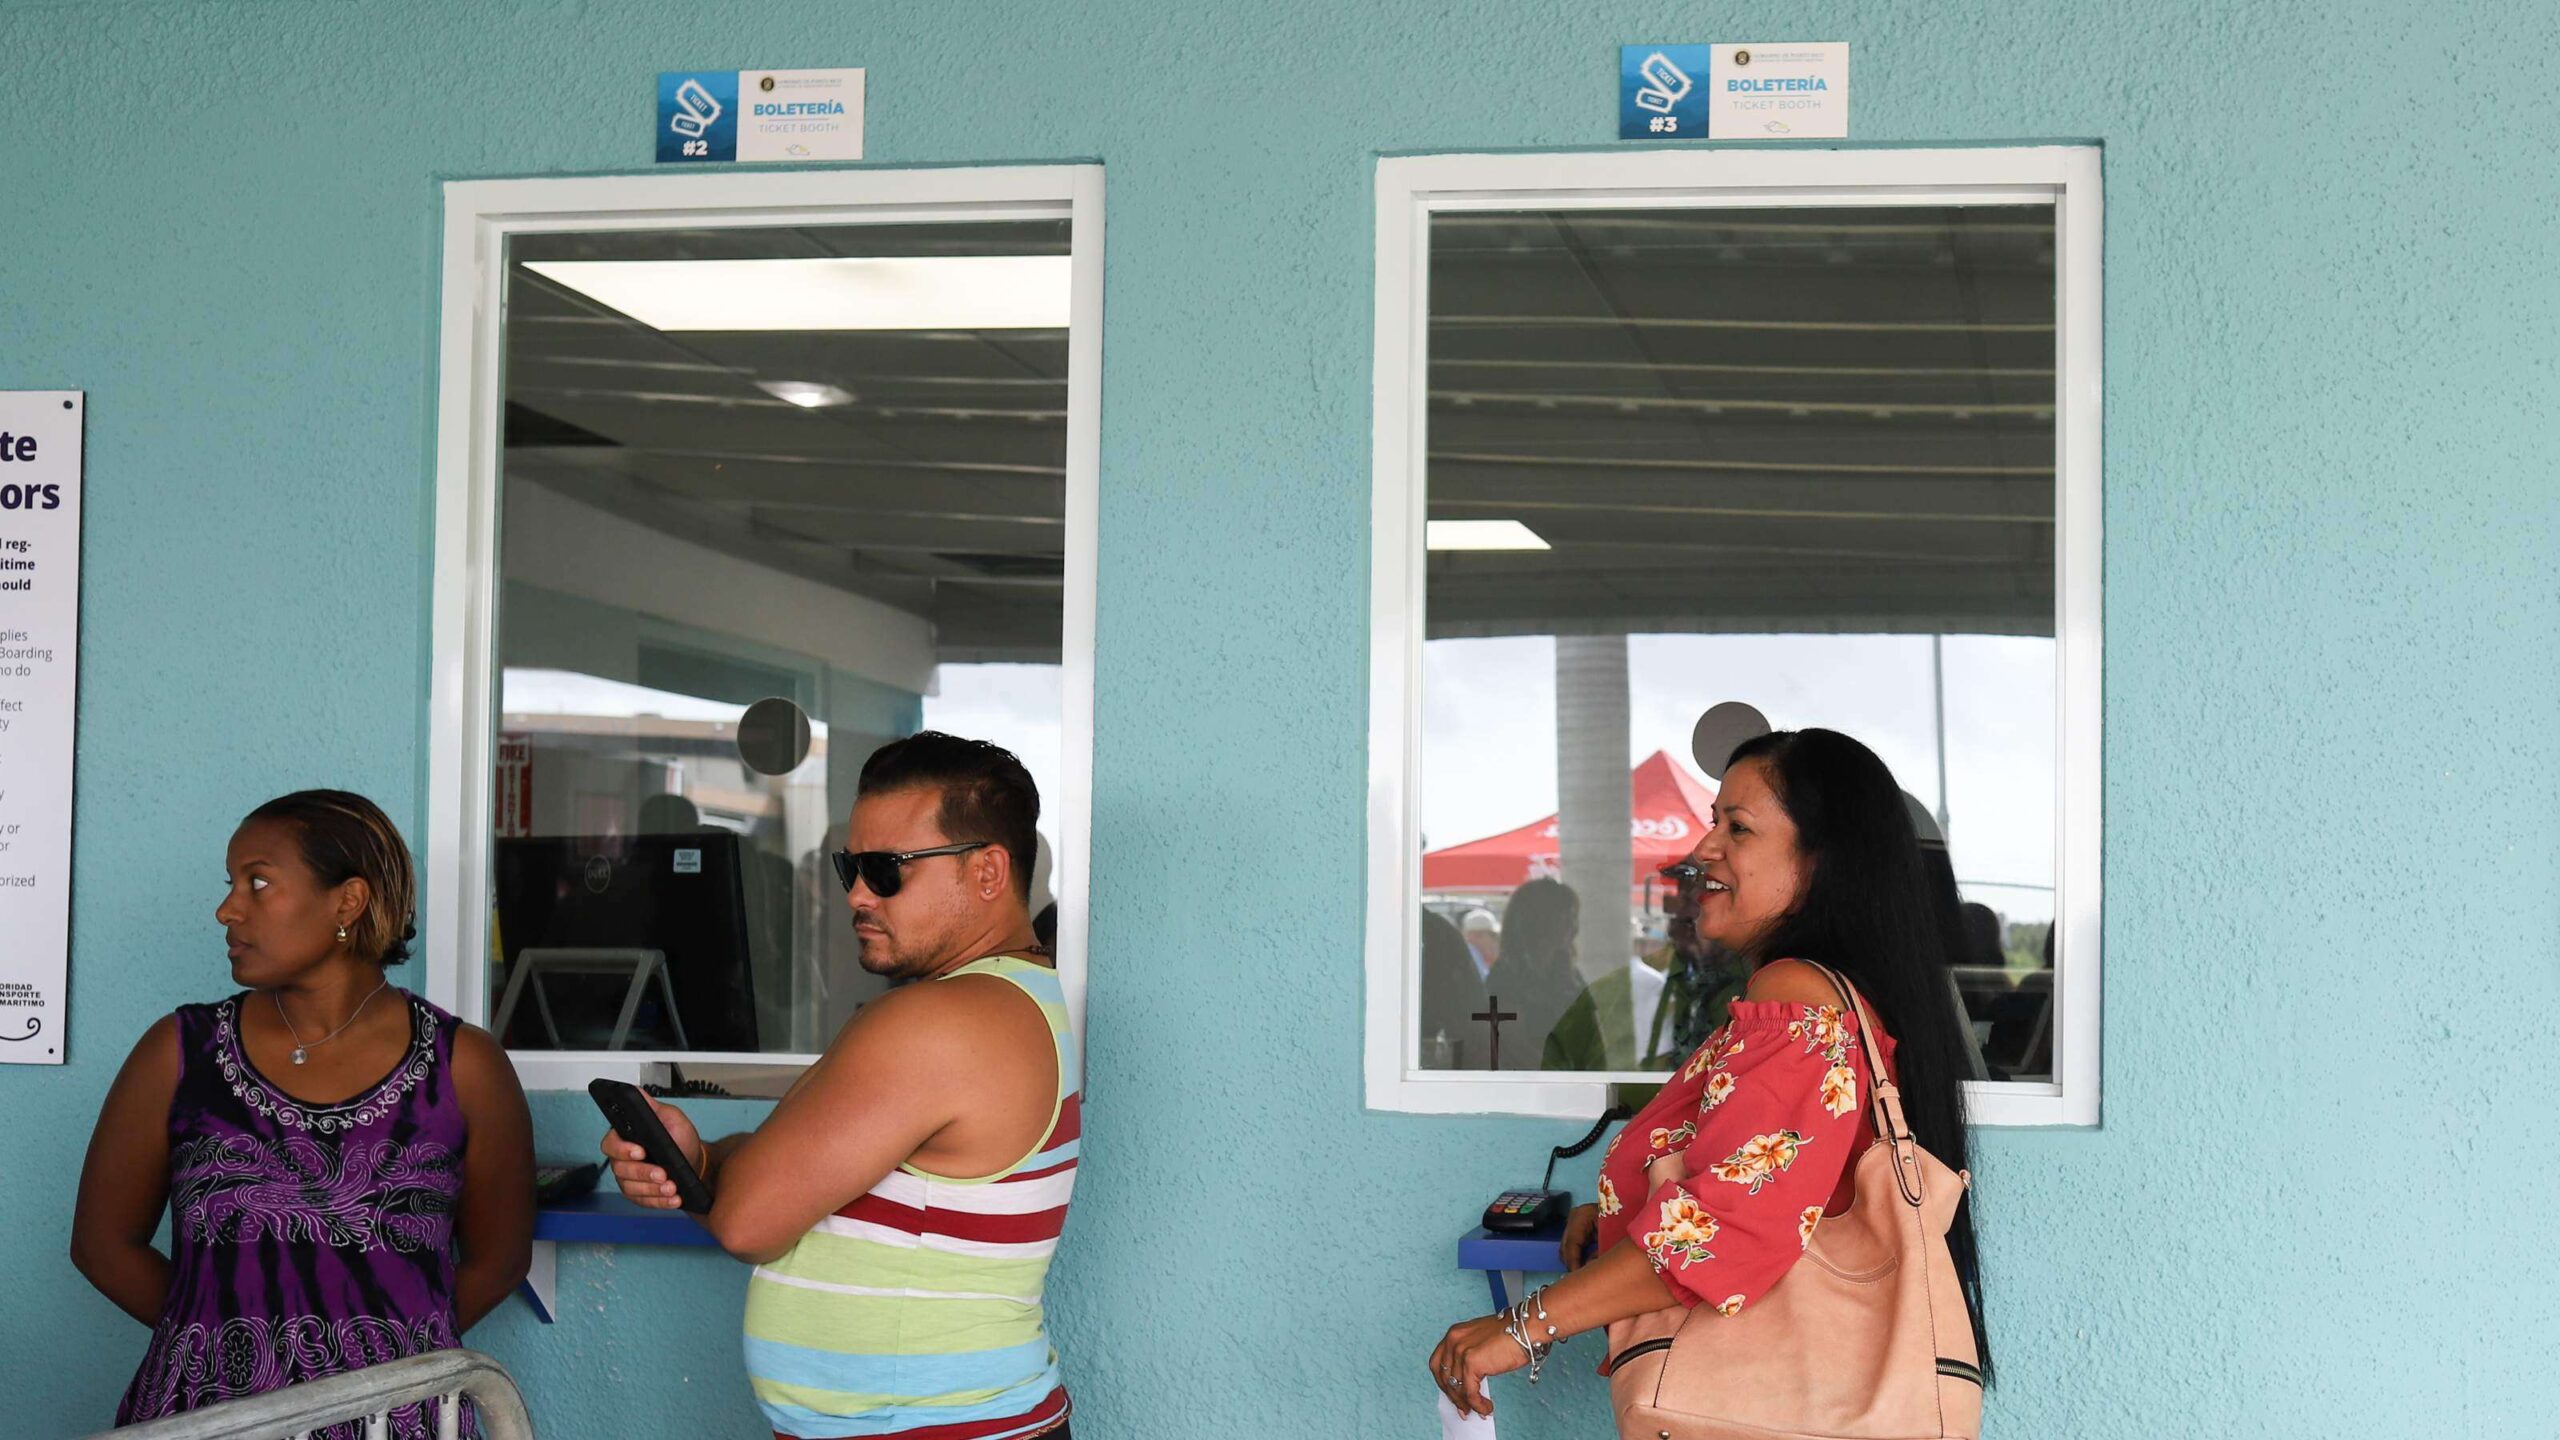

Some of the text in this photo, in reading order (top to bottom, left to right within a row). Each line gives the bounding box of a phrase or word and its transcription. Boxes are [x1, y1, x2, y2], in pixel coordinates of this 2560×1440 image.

[1727, 75, 1827, 92] BOLETERÍA
[754, 99, 844, 116] BOLETERÍA
[1732, 100, 1822, 110] TICKET BOOTH
[760, 122, 839, 133] TICKET BOOTH
[1649, 116, 1678, 132] #3
[683, 140, 708, 156] #2
[0, 432, 37, 462] te
[0, 484, 60, 509] ors
[6, 540, 31, 553] reg-
[0, 579, 31, 590] ould
[0, 646, 53, 662] Boarding
[15, 664, 31, 676] do
[7, 825, 21, 834] or
